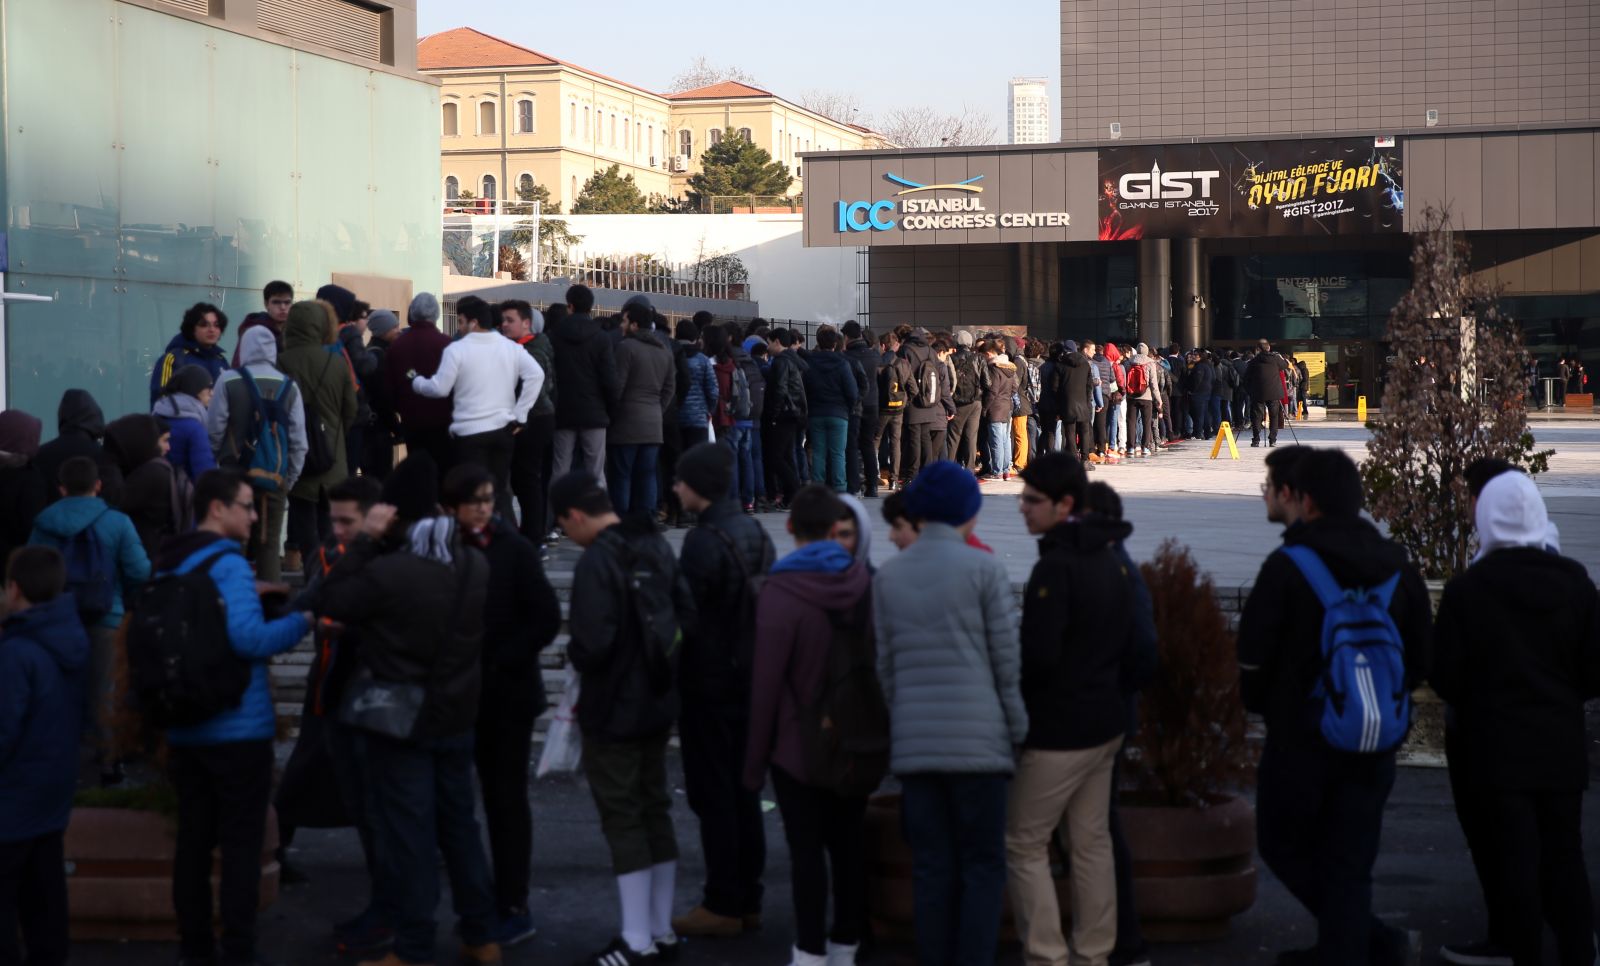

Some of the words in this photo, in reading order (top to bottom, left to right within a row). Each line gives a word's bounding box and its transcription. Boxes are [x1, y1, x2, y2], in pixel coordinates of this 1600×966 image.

[1332, 160, 1344, 170] VE
[1248, 176, 1308, 208] OYUN
[1313, 164, 1380, 196] FUARI
[902, 198, 985, 213] ISTANBUL
[1164, 200, 1219, 208] ISTANBUL
[1283, 199, 1344, 218] #GIST2017
[839, 200, 895, 232] ICC
[1188, 208, 1219, 216] 2017
[902, 213, 996, 230] CONGRESS
[1000, 212, 1070, 227] CENTER
[1276, 276, 1347, 287] ENTRANCE
